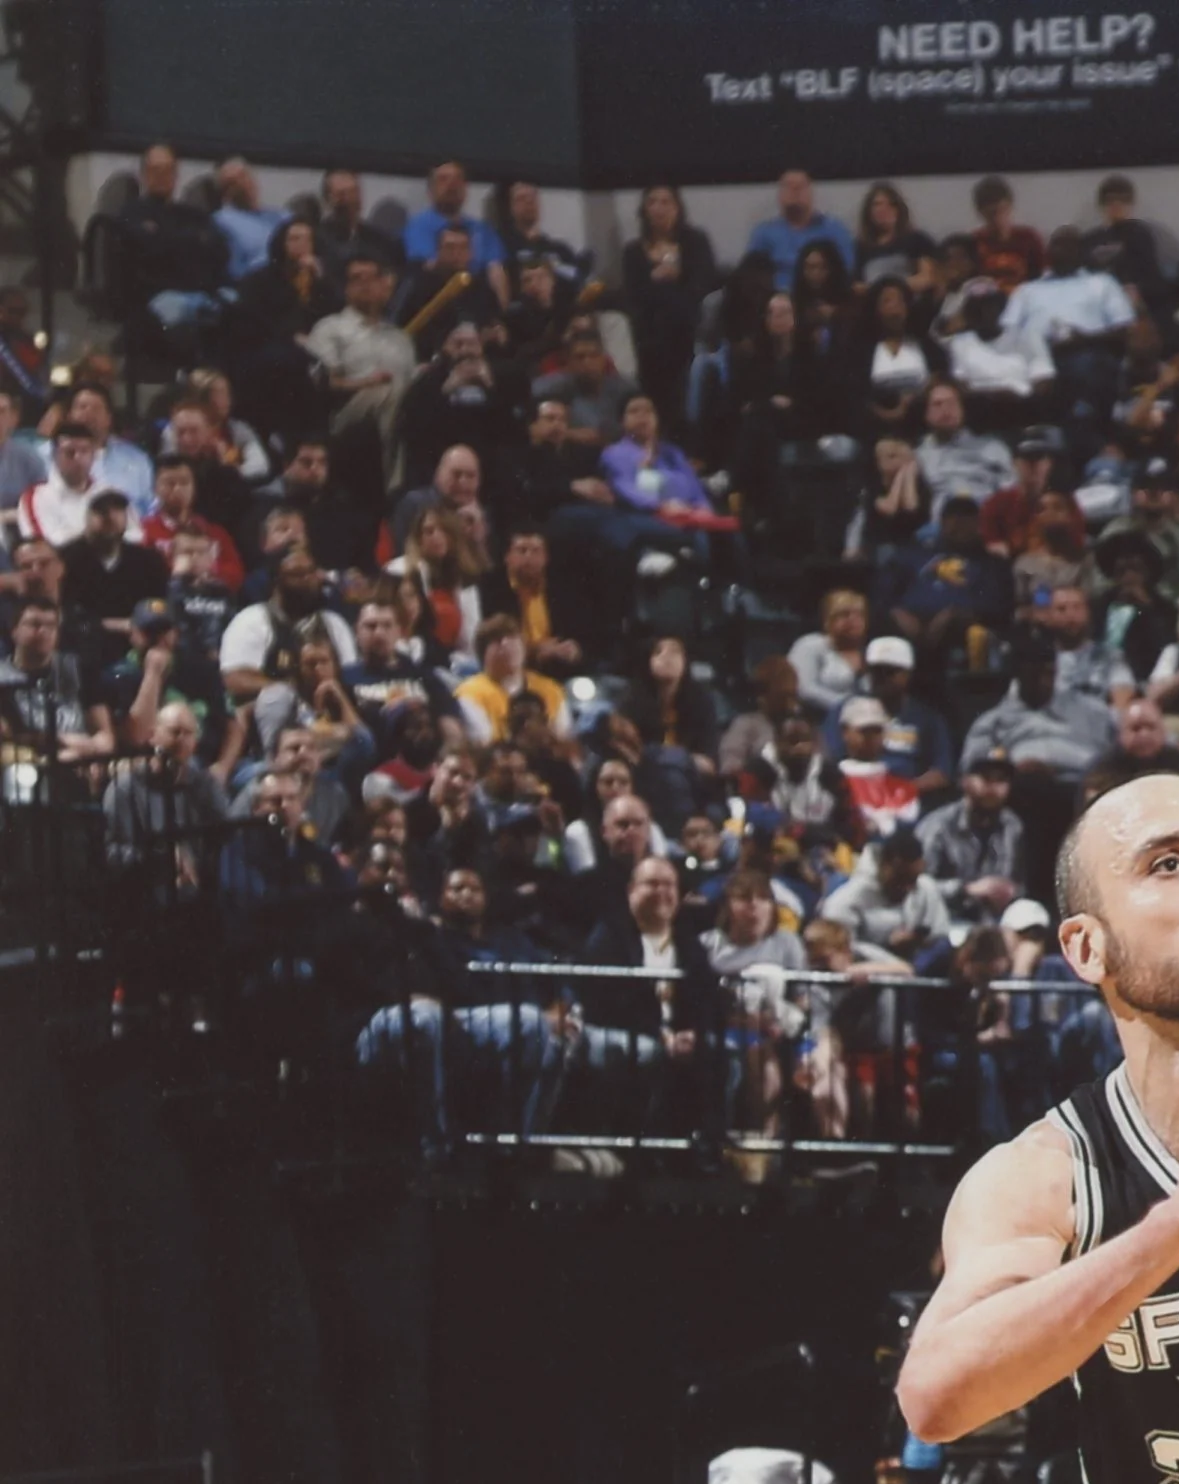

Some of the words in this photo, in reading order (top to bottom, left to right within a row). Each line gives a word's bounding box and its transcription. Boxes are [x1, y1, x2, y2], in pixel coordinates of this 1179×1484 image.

[878, 23, 1000, 60] NEED
[1013, 14, 1154, 55] HELP?
[705, 72, 773, 103] Text
[868, 62, 984, 101] (space)
[992, 62, 1065, 94] your
